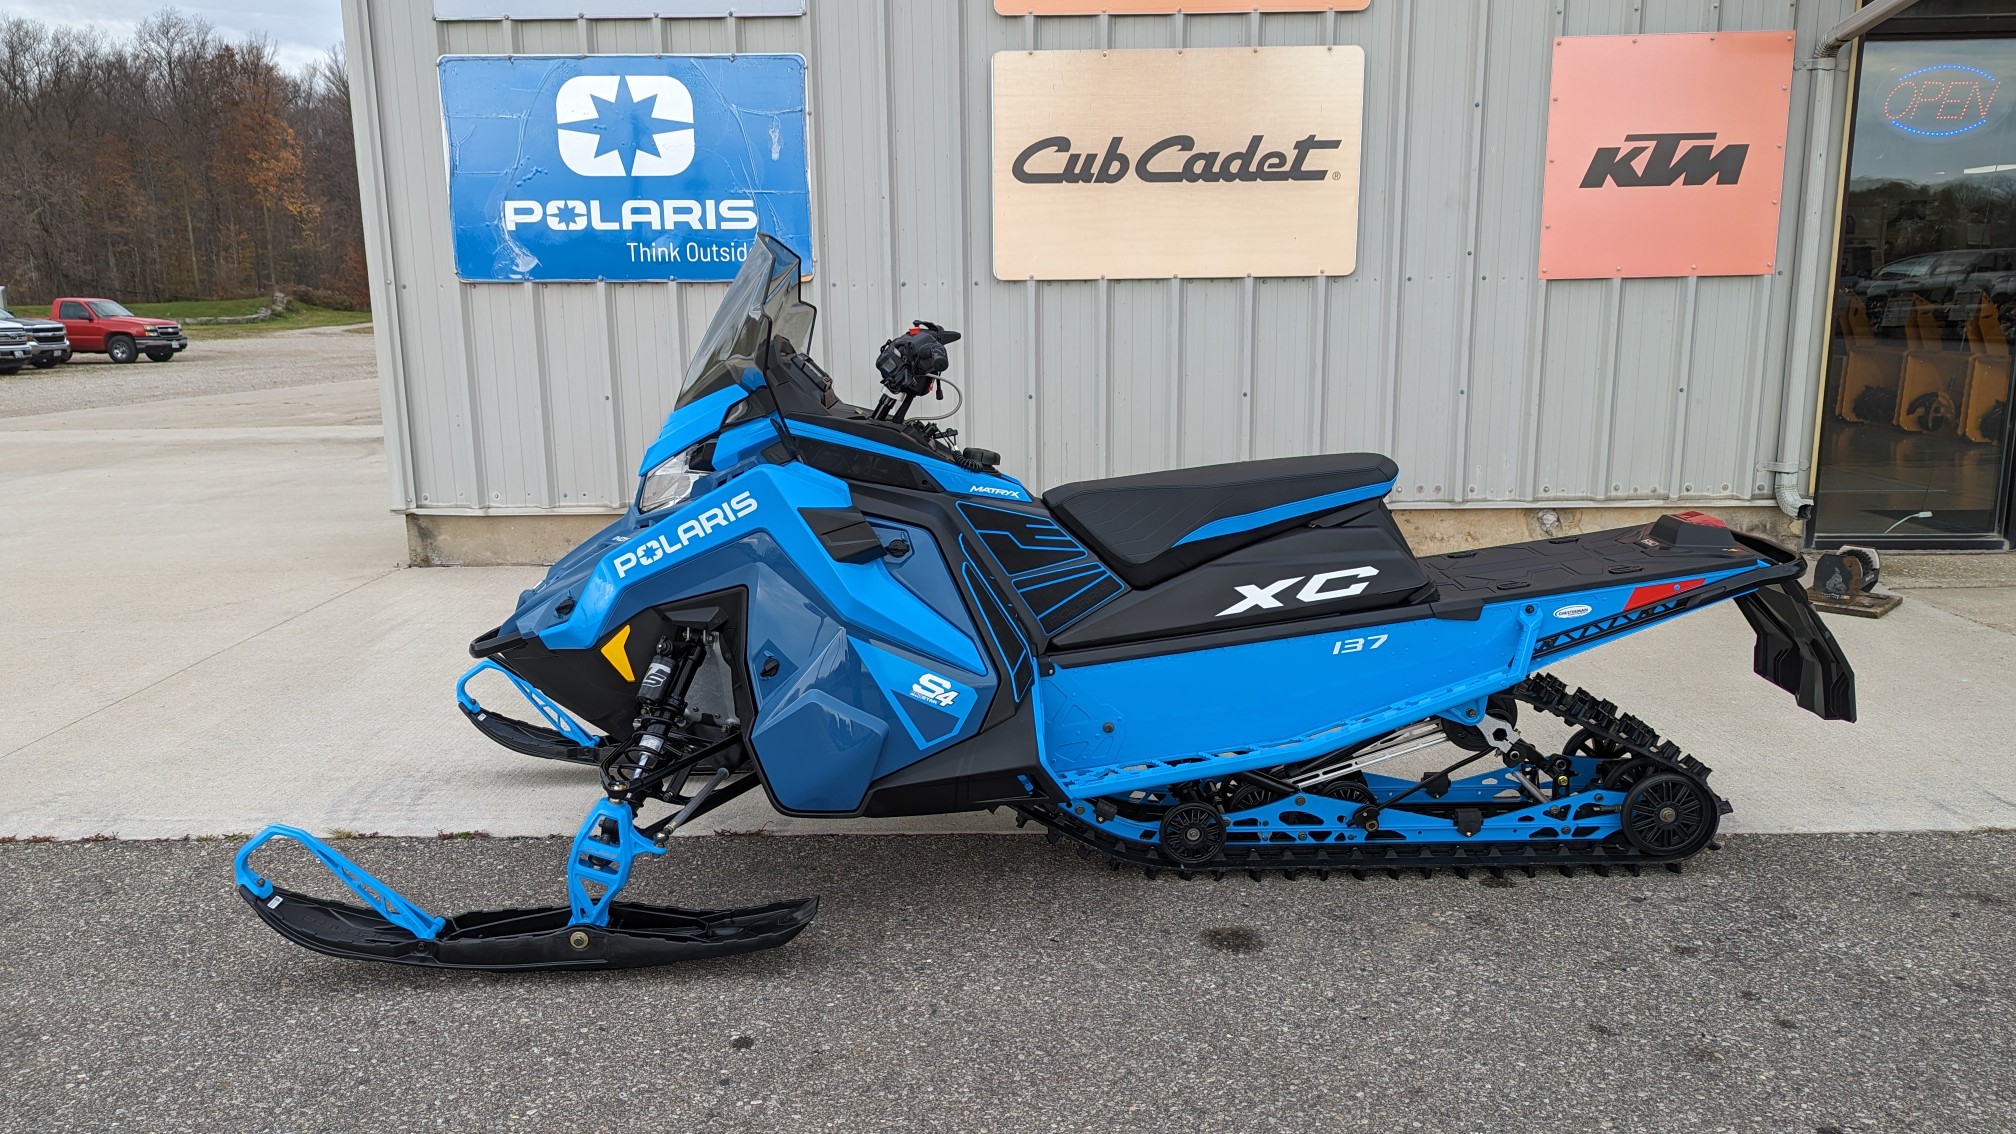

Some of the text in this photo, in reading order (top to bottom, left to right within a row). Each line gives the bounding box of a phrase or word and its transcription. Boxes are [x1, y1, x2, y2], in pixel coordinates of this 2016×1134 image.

[1884, 81, 2001, 120] OPEN
[1011, 133, 1343, 184] Cub Cadet
[1578, 131, 1750, 189] KTM
[503, 200, 757, 231] POLARIS
[626, 242, 753, 262] Think Outsid
[970, 485, 1020, 499] MATRYX
[613, 490, 758, 579] POLARIS
[1214, 565, 1380, 617] XC
[1332, 634, 1389, 655] 137
